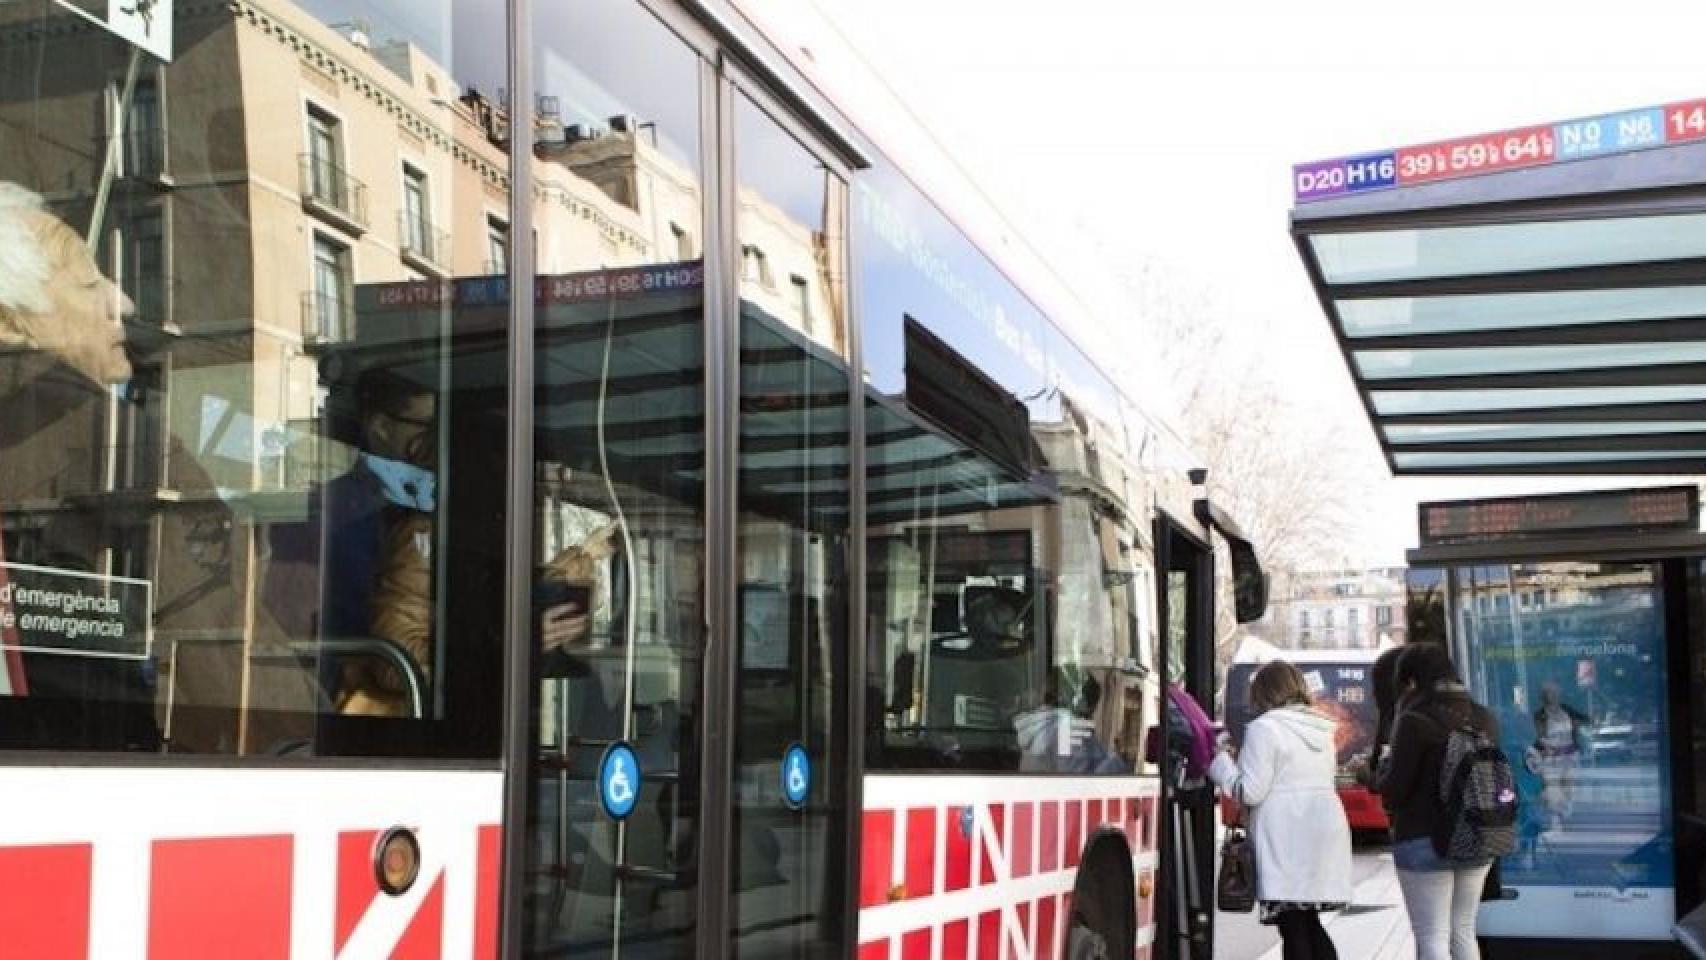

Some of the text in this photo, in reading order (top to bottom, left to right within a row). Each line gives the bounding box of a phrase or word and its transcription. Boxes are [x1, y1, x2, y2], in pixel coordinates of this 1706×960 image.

[1298, 169, 1344, 192] D20
[1346, 159, 1395, 184] H16
[1401, 153, 1433, 177] 39
[1451, 143, 1486, 170] 59
[1503, 133, 1539, 161] 64
[0, 583, 121, 614] d'emergència
[20, 613, 125, 639] emergencia
